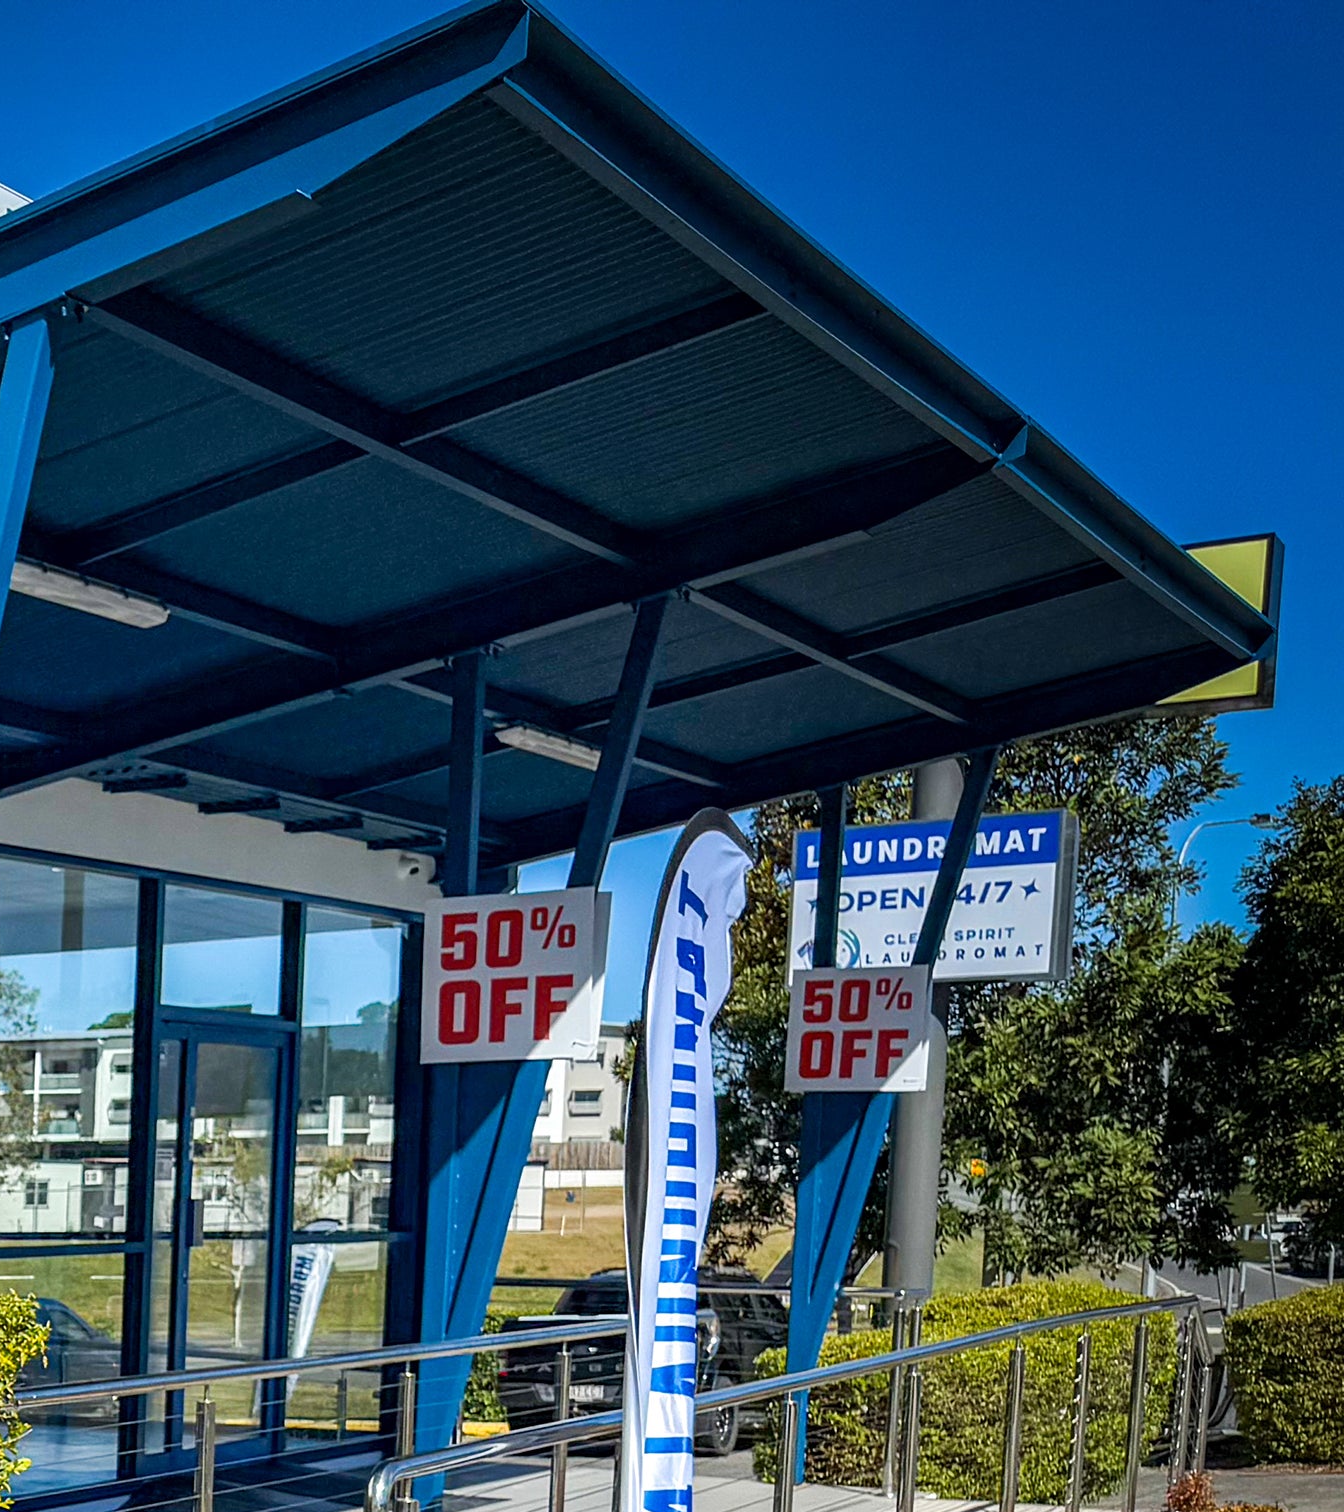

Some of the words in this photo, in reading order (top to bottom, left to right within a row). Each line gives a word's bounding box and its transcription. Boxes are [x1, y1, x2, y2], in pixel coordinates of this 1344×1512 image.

[807, 827, 1047, 869] LUNDRMAT
[839, 886, 925, 913] OPEN
[956, 881, 1013, 905] 4/7
[441, 905, 576, 971] 50%
[865, 944, 1044, 965] LAUDROMAT
[884, 931, 945, 945] CLE
[954, 927, 1015, 942] SPIRIT
[439, 975, 574, 1045] OFF
[804, 978, 913, 1024] 50%
[799, 1029, 909, 1080] OFF
